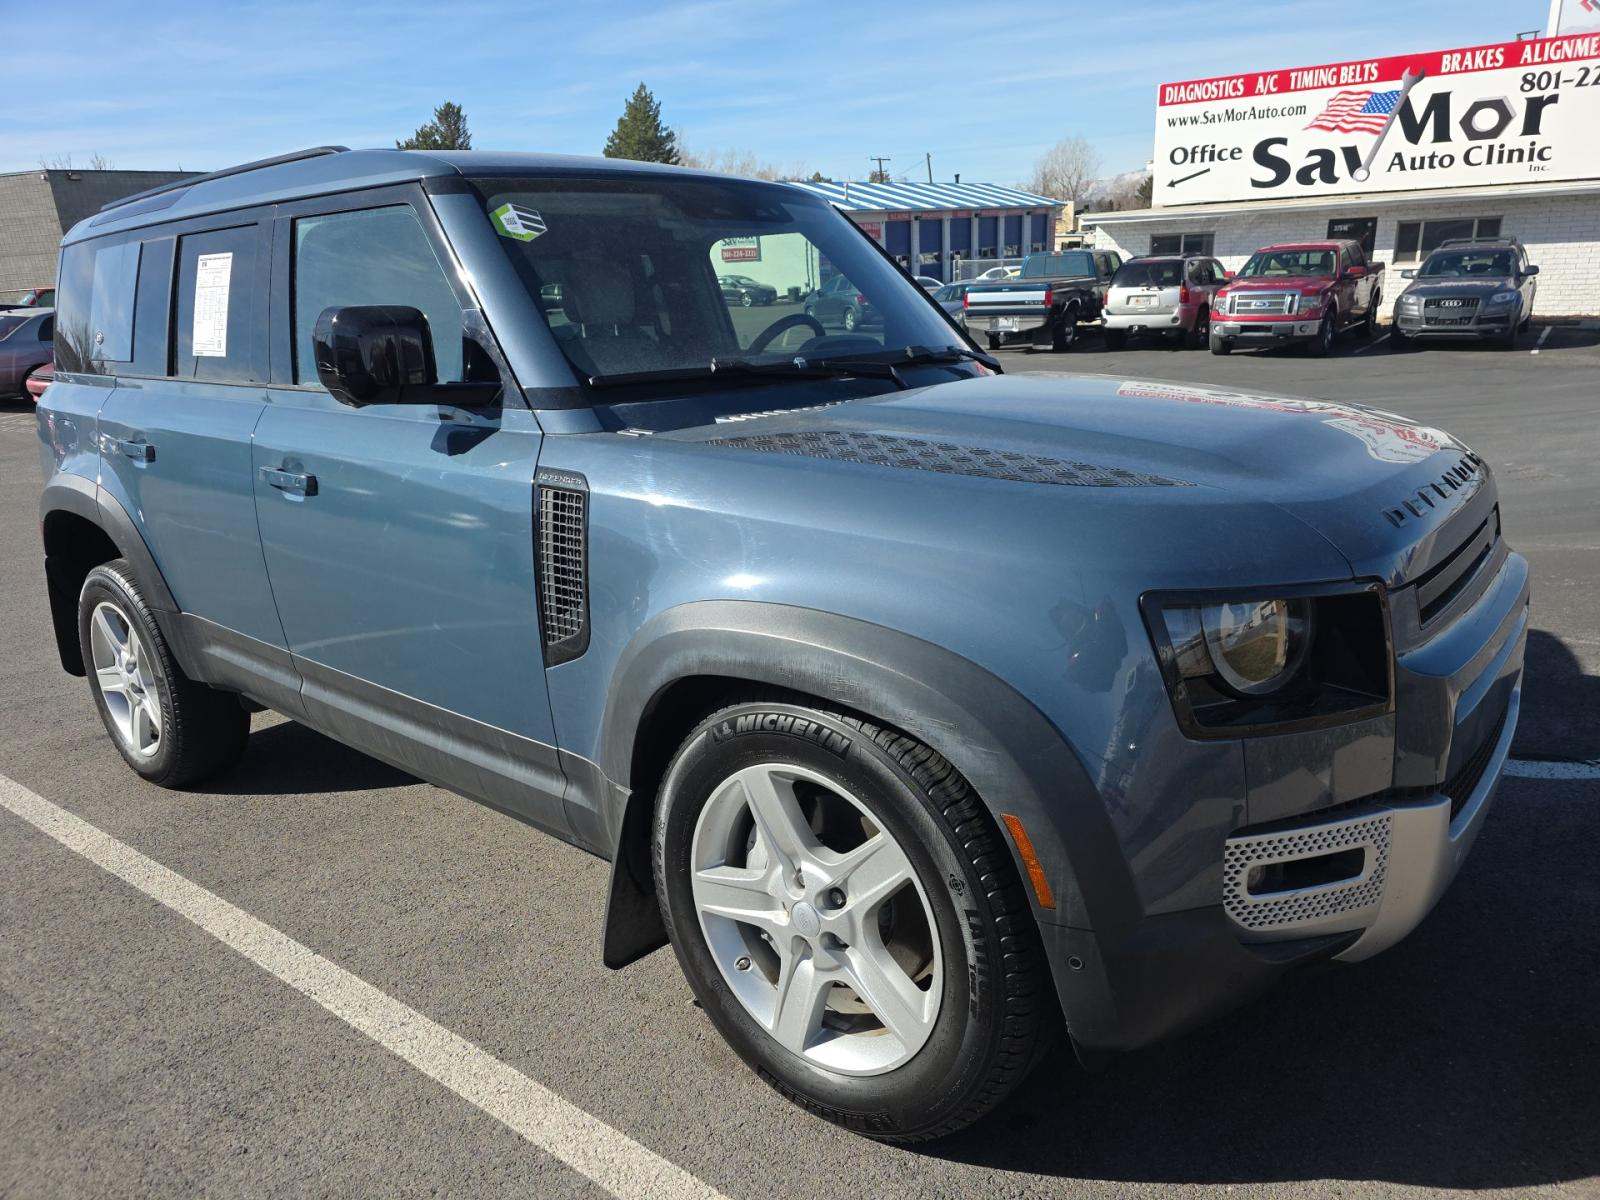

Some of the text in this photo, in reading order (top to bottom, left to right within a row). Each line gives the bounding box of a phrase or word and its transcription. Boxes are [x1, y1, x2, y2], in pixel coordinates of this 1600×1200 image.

[1165, 78, 1245, 104] DIAGNOSTICS
[1255, 74, 1278, 96] A/C
[1289, 67, 1337, 90] TIMING
[1339, 62, 1379, 84] BELTS
[1440, 47, 1505, 74] BRAKES
[1167, 103, 1307, 128] www.SavMorAuto.com
[1169, 144, 1243, 166] Office
[1386, 141, 1552, 173] Auto Clinic
[735, 713, 852, 753] MICHELIN
